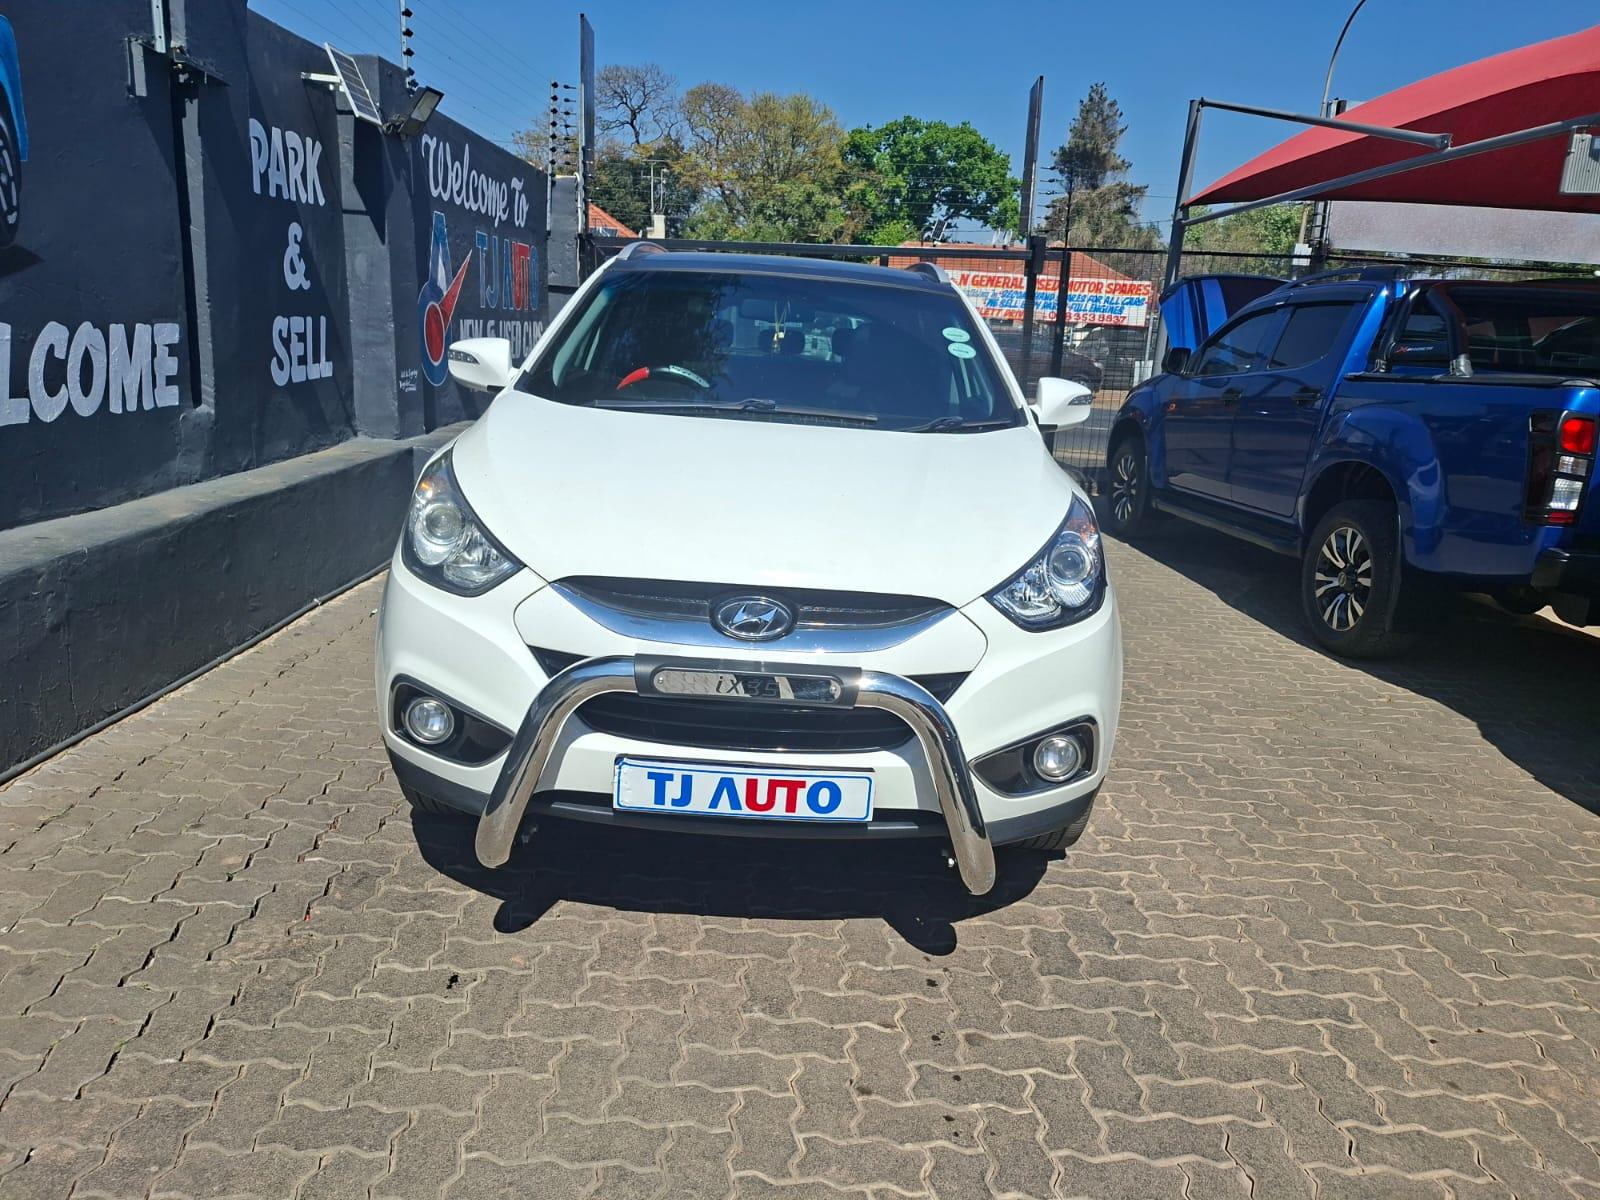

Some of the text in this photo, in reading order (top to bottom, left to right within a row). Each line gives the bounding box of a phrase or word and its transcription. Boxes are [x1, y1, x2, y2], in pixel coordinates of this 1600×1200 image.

[249, 118, 325, 207] PARK
[421, 133, 529, 228] Welcome To
[283, 222, 310, 290] &
[476, 230, 539, 311] TJ AUTO
[971, 274, 1025, 290] GENERAL
[1104, 282, 1151, 296] SPARES
[0, 322, 180, 425] LCOME
[272, 315, 333, 387] SELL
[647, 771, 842, 815] TJ AUTO
